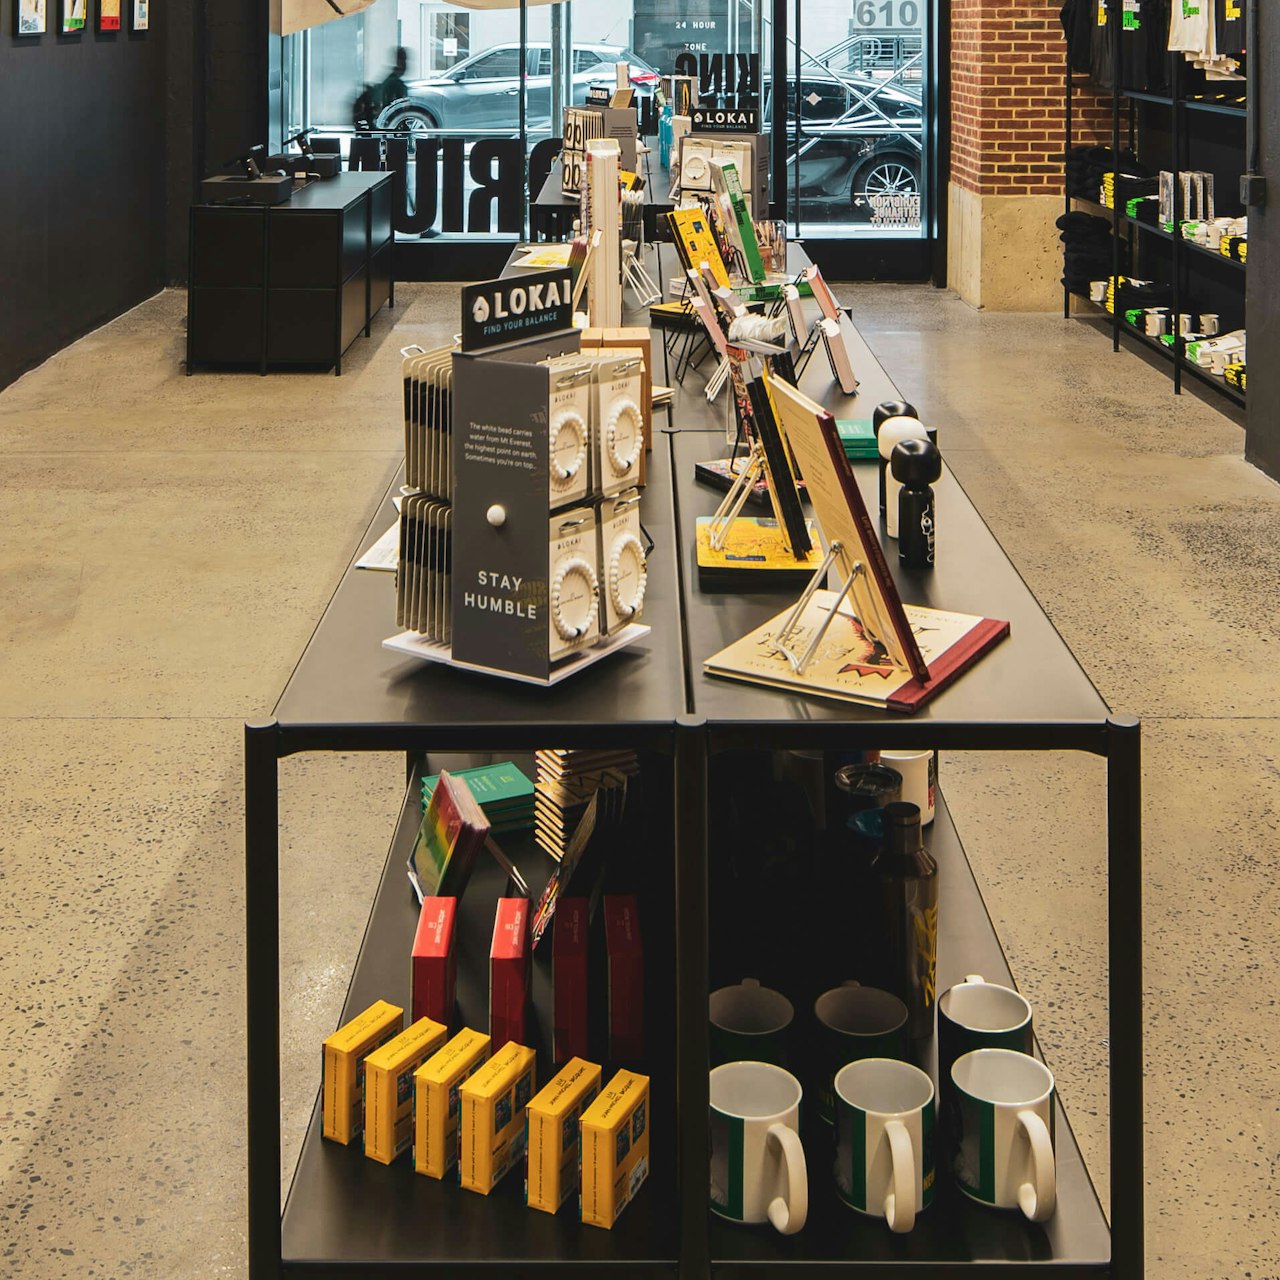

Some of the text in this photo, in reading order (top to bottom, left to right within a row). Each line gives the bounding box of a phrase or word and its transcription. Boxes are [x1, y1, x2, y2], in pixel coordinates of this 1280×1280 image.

[856, 0, 919, 27] 610
[675, 21, 716, 29] 24 HOUR
[684, 43, 707, 51] ZONE
[706, 112, 754, 124] LOKAI
[494, 279, 571, 319] LOKAI
[483, 311, 558, 335] FIND YOUR BALANCE
[469, 422, 532, 437] The white bead carries
[469, 433, 485, 442] water
[486, 434, 499, 443] from
[464, 442, 474, 451] the
[475, 444, 496, 455] highest
[496, 447, 511, 457] point
[464, 453, 496, 464] Sometimes
[496, 457, 514, 468] you're
[478, 570, 523, 592] STAY
[464, 592, 537, 619] HUMBLE
